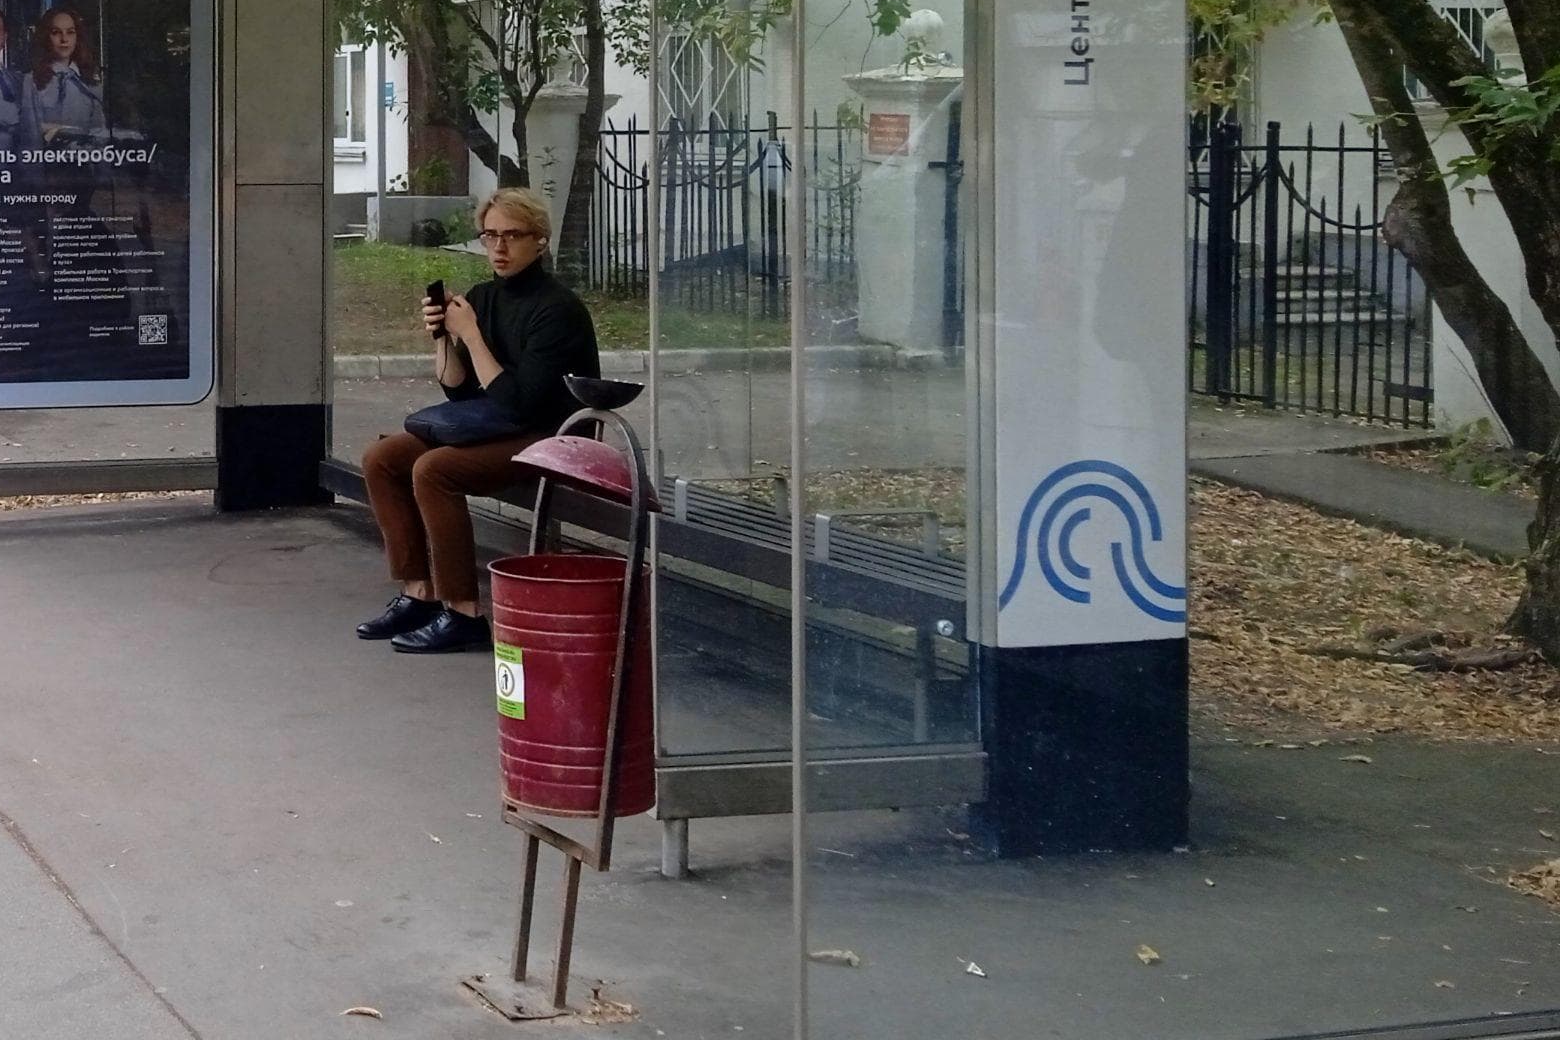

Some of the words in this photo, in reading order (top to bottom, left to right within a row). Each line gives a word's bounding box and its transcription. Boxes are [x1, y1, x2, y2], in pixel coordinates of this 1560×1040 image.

[21, 143, 158, 166] электробуса/
[3, 194, 38, 206] нужна
[40, 193, 77, 205] городу
